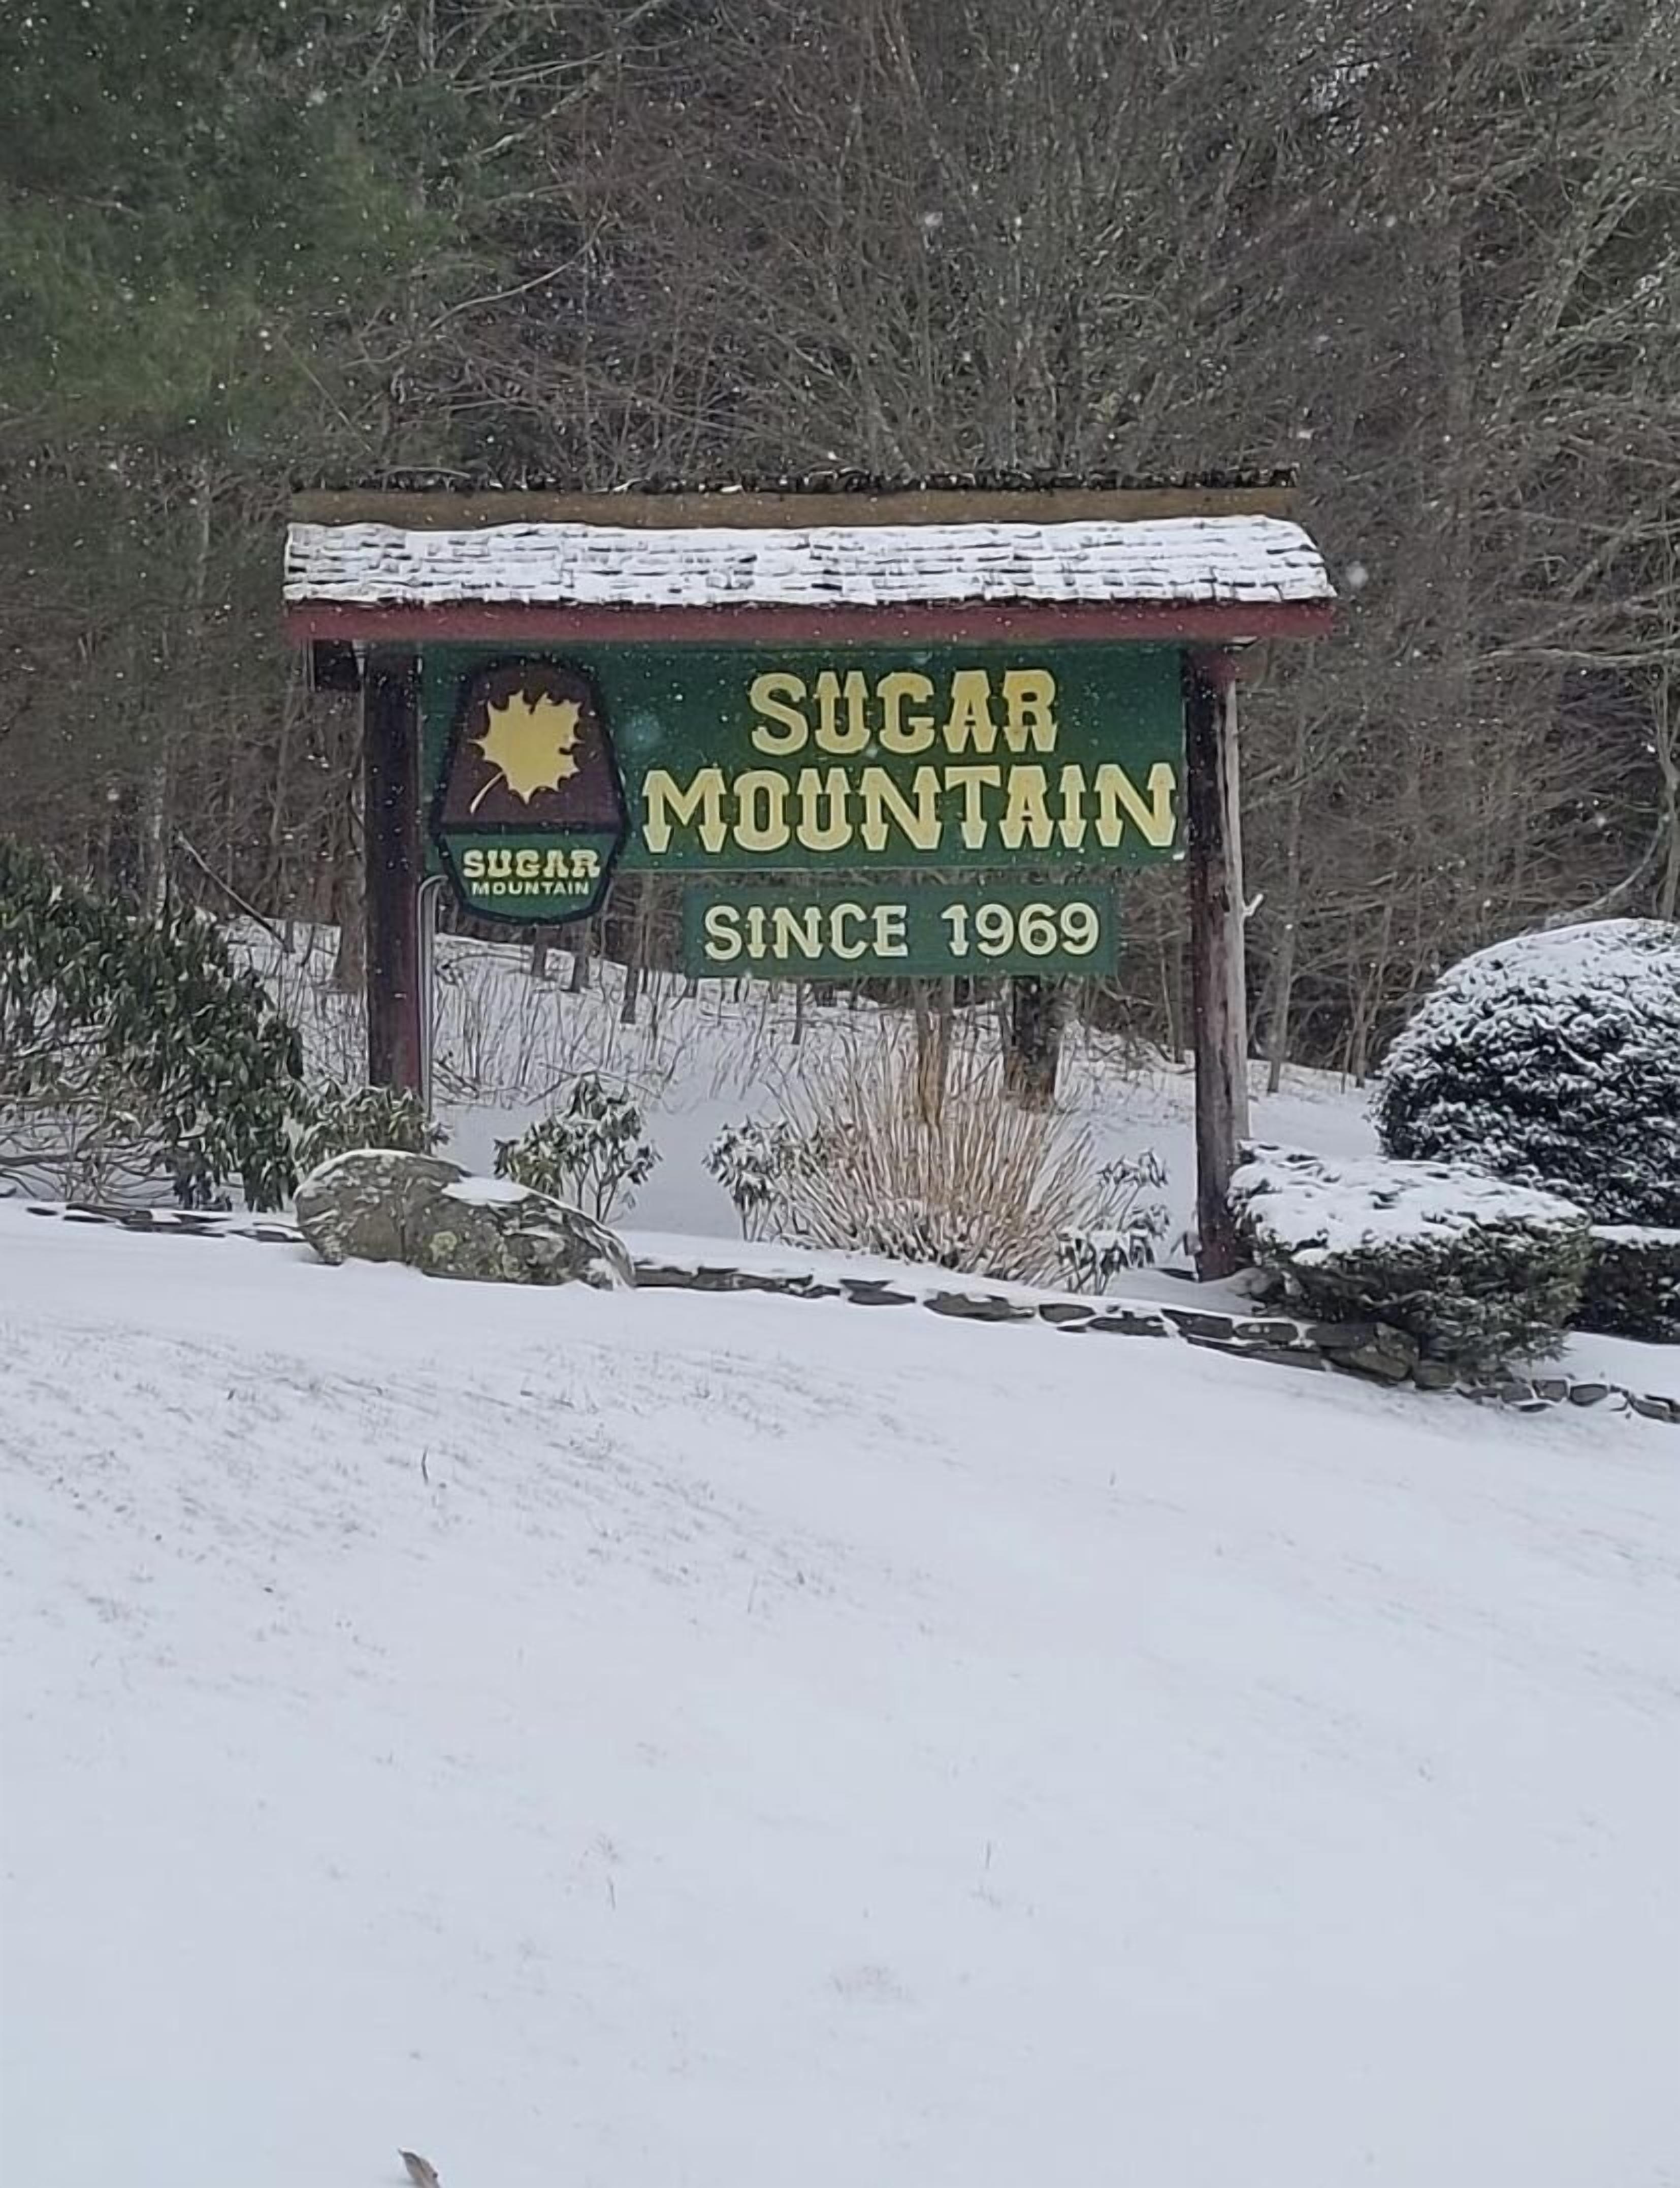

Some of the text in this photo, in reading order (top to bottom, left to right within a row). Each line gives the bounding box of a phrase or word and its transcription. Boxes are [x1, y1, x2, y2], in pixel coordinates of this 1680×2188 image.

[749, 669, 1057, 755] SUGAR
[641, 762, 1176, 853] MOUNTAIN
[463, 849, 601, 878] SUGAR
[471, 881, 590, 895] MOUNTAIN
[704, 902, 1099, 960] SINCE 1969
